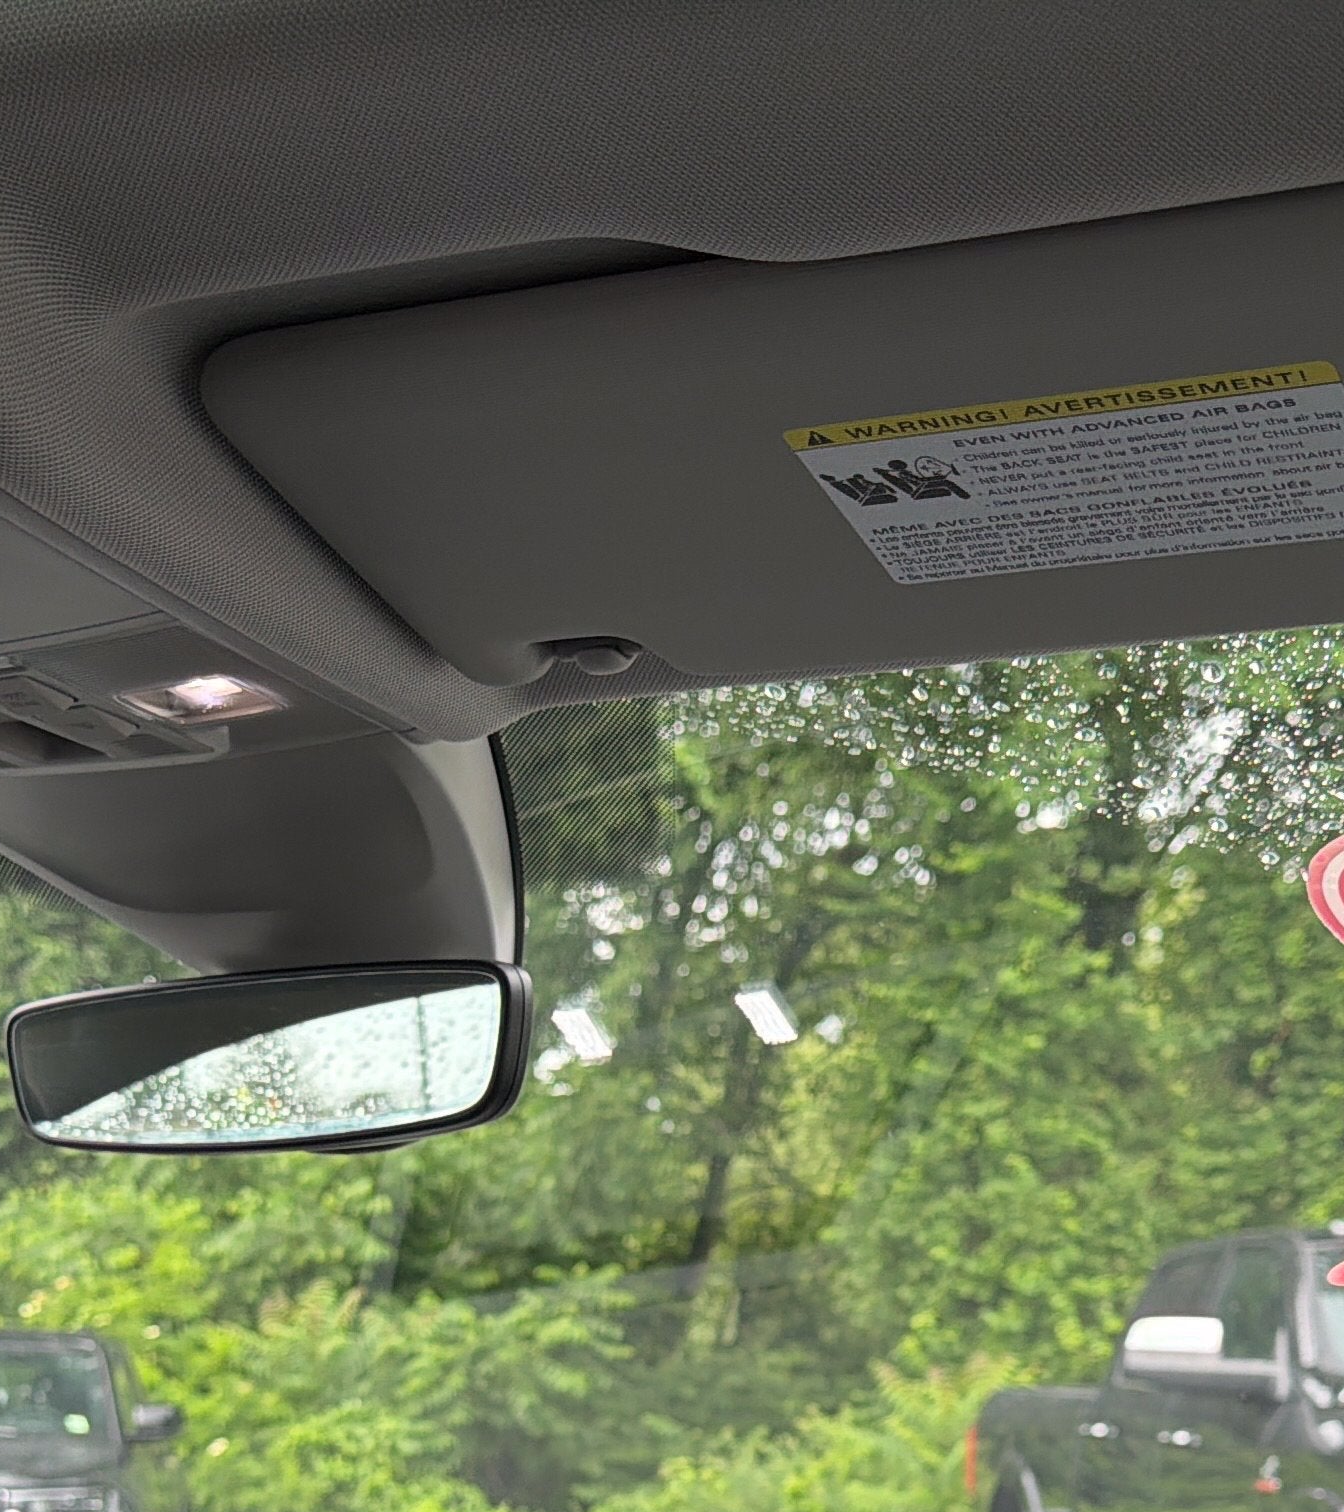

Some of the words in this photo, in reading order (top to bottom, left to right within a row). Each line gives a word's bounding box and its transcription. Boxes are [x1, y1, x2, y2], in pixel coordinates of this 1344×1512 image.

[843, 407, 1010, 439] WARNING!
[1018, 369, 1309, 417] AVERTISSEMENT!
[952, 435, 1006, 447] EVEN
[1010, 427, 1065, 440] WITH
[1069, 412, 1185, 433] ADVANCED
[1190, 407, 1228, 418] AIR
[1235, 398, 1297, 413] BAGS
[962, 449, 1018, 462] Children
[1021, 447, 1046, 455] can
[1242, 419, 1261, 429] by
[1264, 416, 1289, 425] the
[971, 465, 996, 473] The
[1001, 459, 1042, 470] BACK
[1046, 454, 1082, 464] SEAT
[1130, 441, 1189, 454] SAFEST
[1262, 423, 1341, 439] CHILDREN
[979, 473, 1028, 485] NEVER
[1030, 470, 1055, 480] put
[987, 483, 1049, 496] ALWAYS
[933, 517, 983, 529] AVEC
